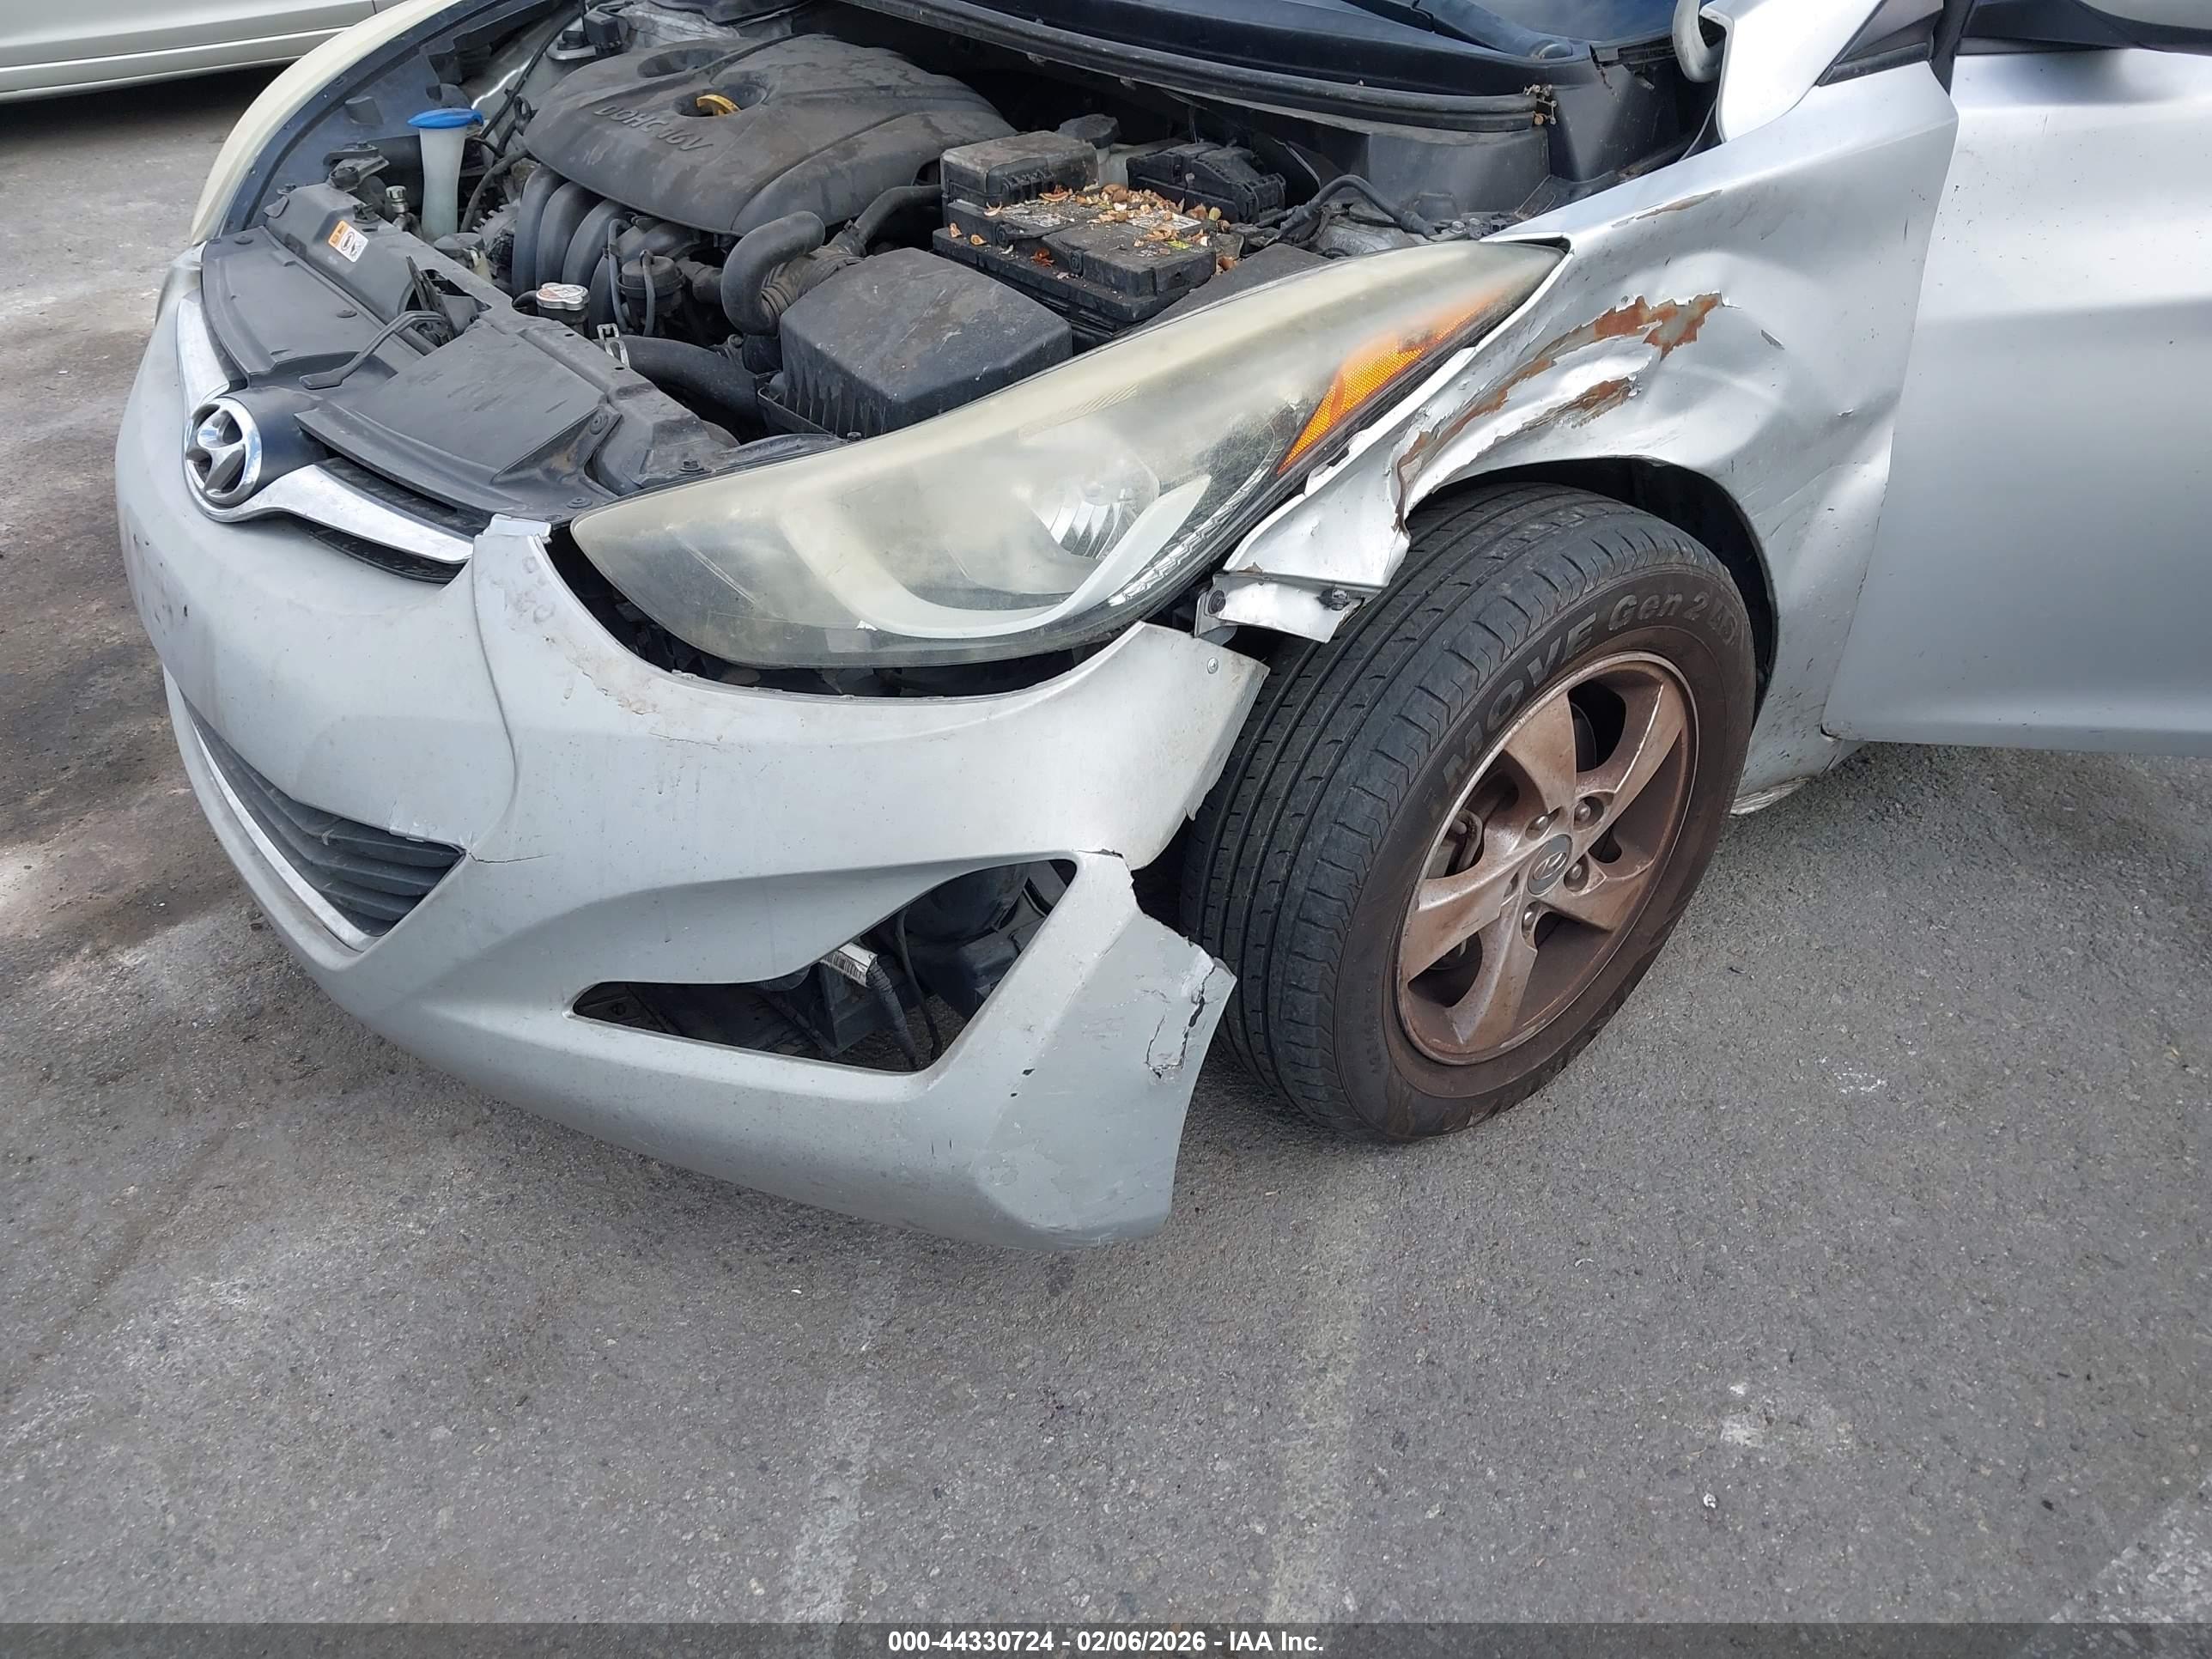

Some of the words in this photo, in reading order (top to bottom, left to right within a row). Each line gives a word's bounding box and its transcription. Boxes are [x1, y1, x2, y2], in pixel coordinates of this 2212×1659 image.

[593, 105, 669, 132] DOHC
[657, 127, 714, 152] 16V
[1608, 594, 1684, 631] Gen
